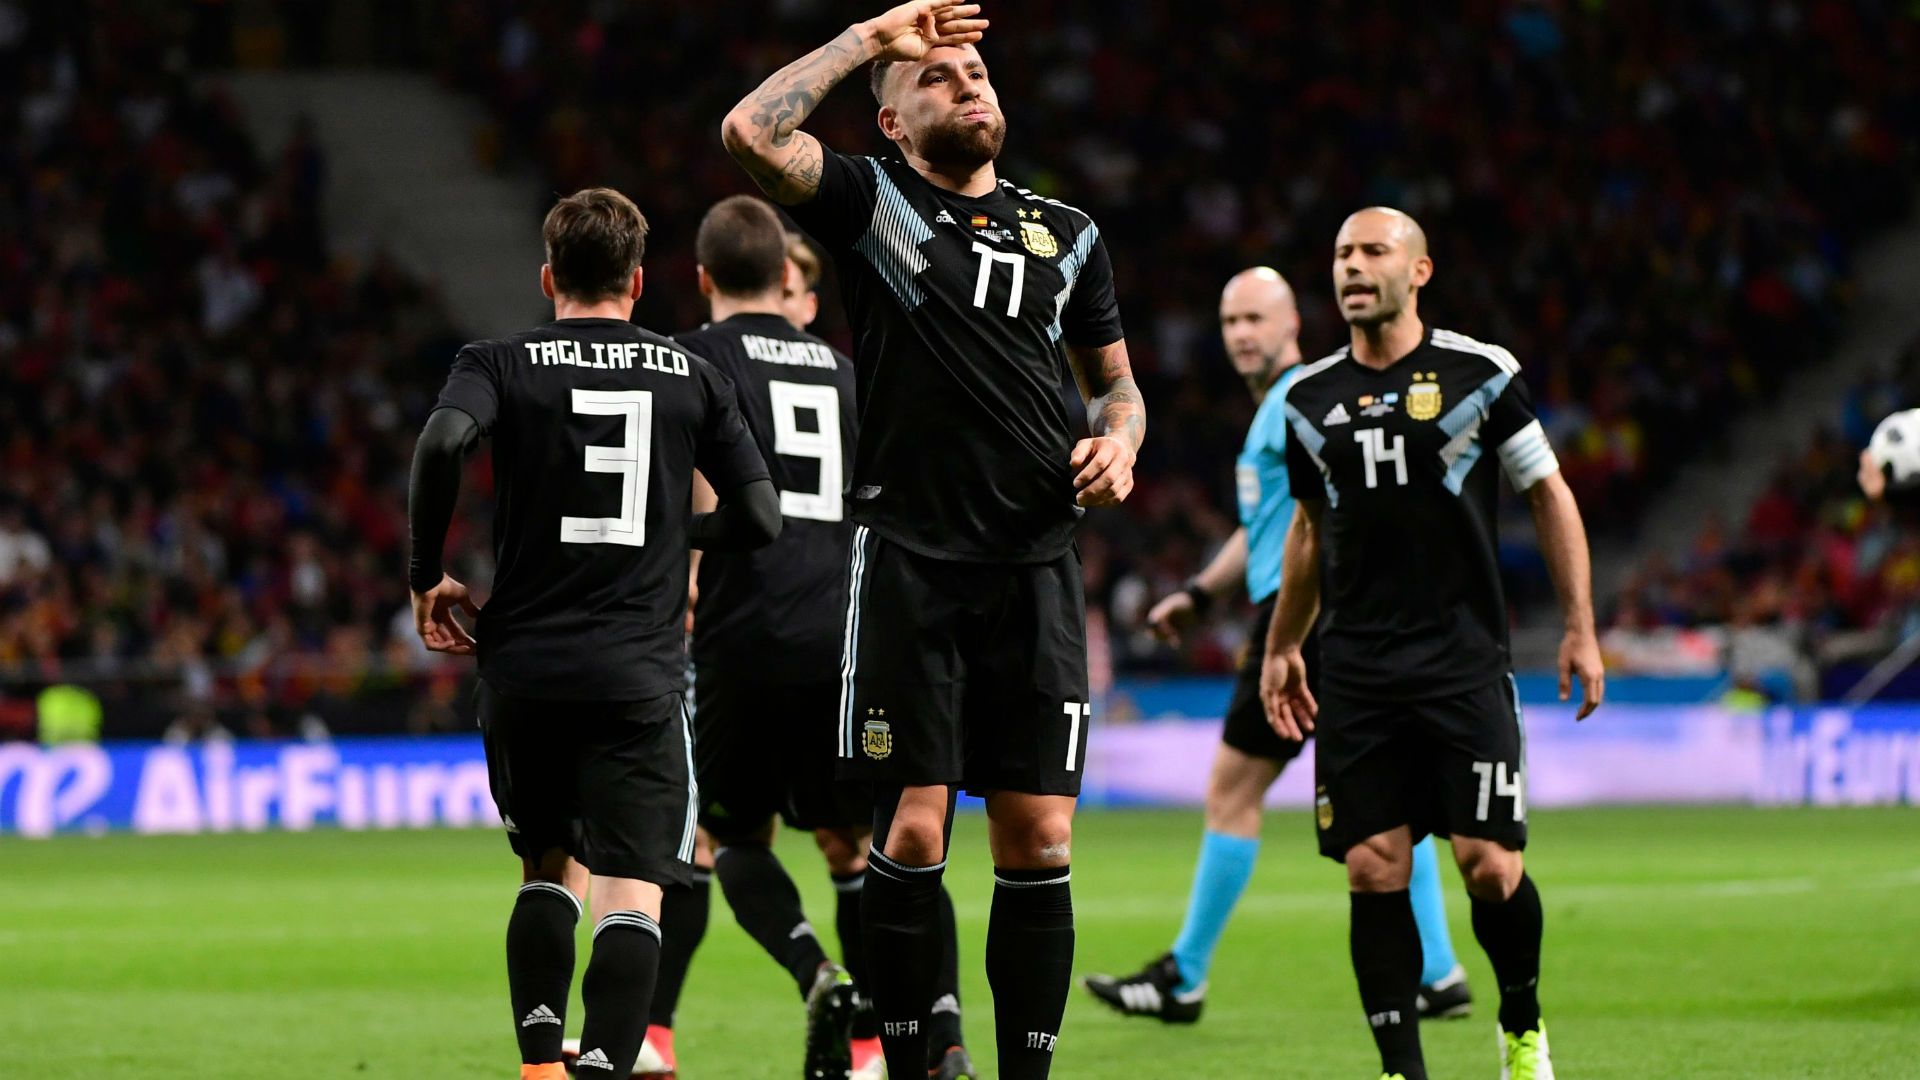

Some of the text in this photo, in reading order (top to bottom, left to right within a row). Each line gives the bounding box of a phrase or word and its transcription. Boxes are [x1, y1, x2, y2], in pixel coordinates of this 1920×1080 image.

[971, 241, 1025, 318] 17
[524, 340, 690, 377] TAGLIAFICO
[560, 389, 653, 547] 3
[768, 380, 844, 522] 9
[1353, 427, 1409, 489] 14
[132, 740, 502, 832] AirEuro
[1472, 762, 1523, 822] 14
[521, 1015, 562, 1028] adidas
[884, 1020, 919, 1036] AFA
[1027, 1031, 1058, 1052] AFA
[576, 1058, 614, 1071] adidas
